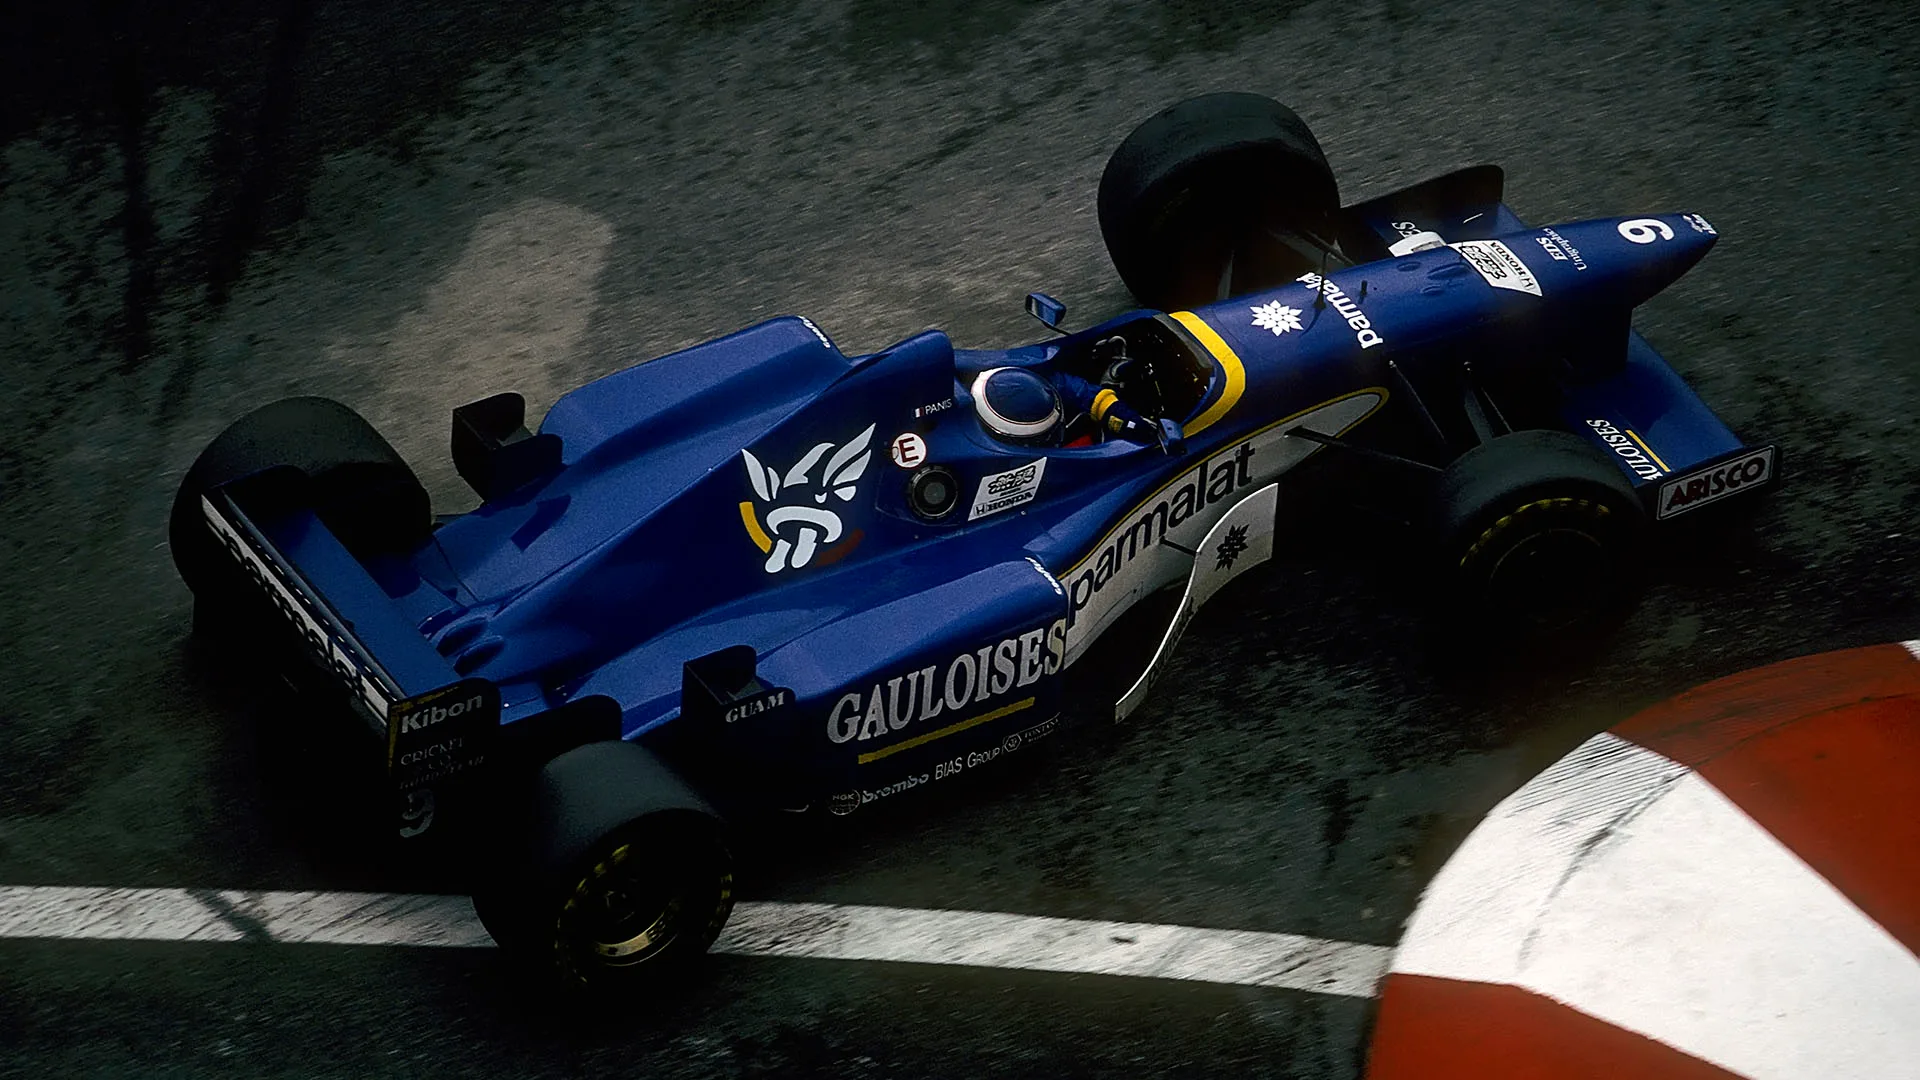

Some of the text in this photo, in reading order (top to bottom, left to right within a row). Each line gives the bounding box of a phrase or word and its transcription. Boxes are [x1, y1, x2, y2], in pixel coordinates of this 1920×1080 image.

[1490, 241, 1526, 276] HONDA
[1535, 237, 1568, 261] EDS
[1295, 272, 1384, 349] parmalat
[924, 398, 953, 416] PANIS
[898, 436, 919, 463] E
[988, 492, 1033, 511] HONDA
[1665, 457, 1766, 511] ARISCO
[1068, 441, 1256, 629] parmalat
[826, 617, 1067, 744] GAULOISES
[400, 694, 483, 734] Kibon
[724, 692, 785, 724] GUAM
[862, 772, 930, 804] brembo
[934, 756, 963, 780] BIAS
[399, 788, 436, 838] 9
